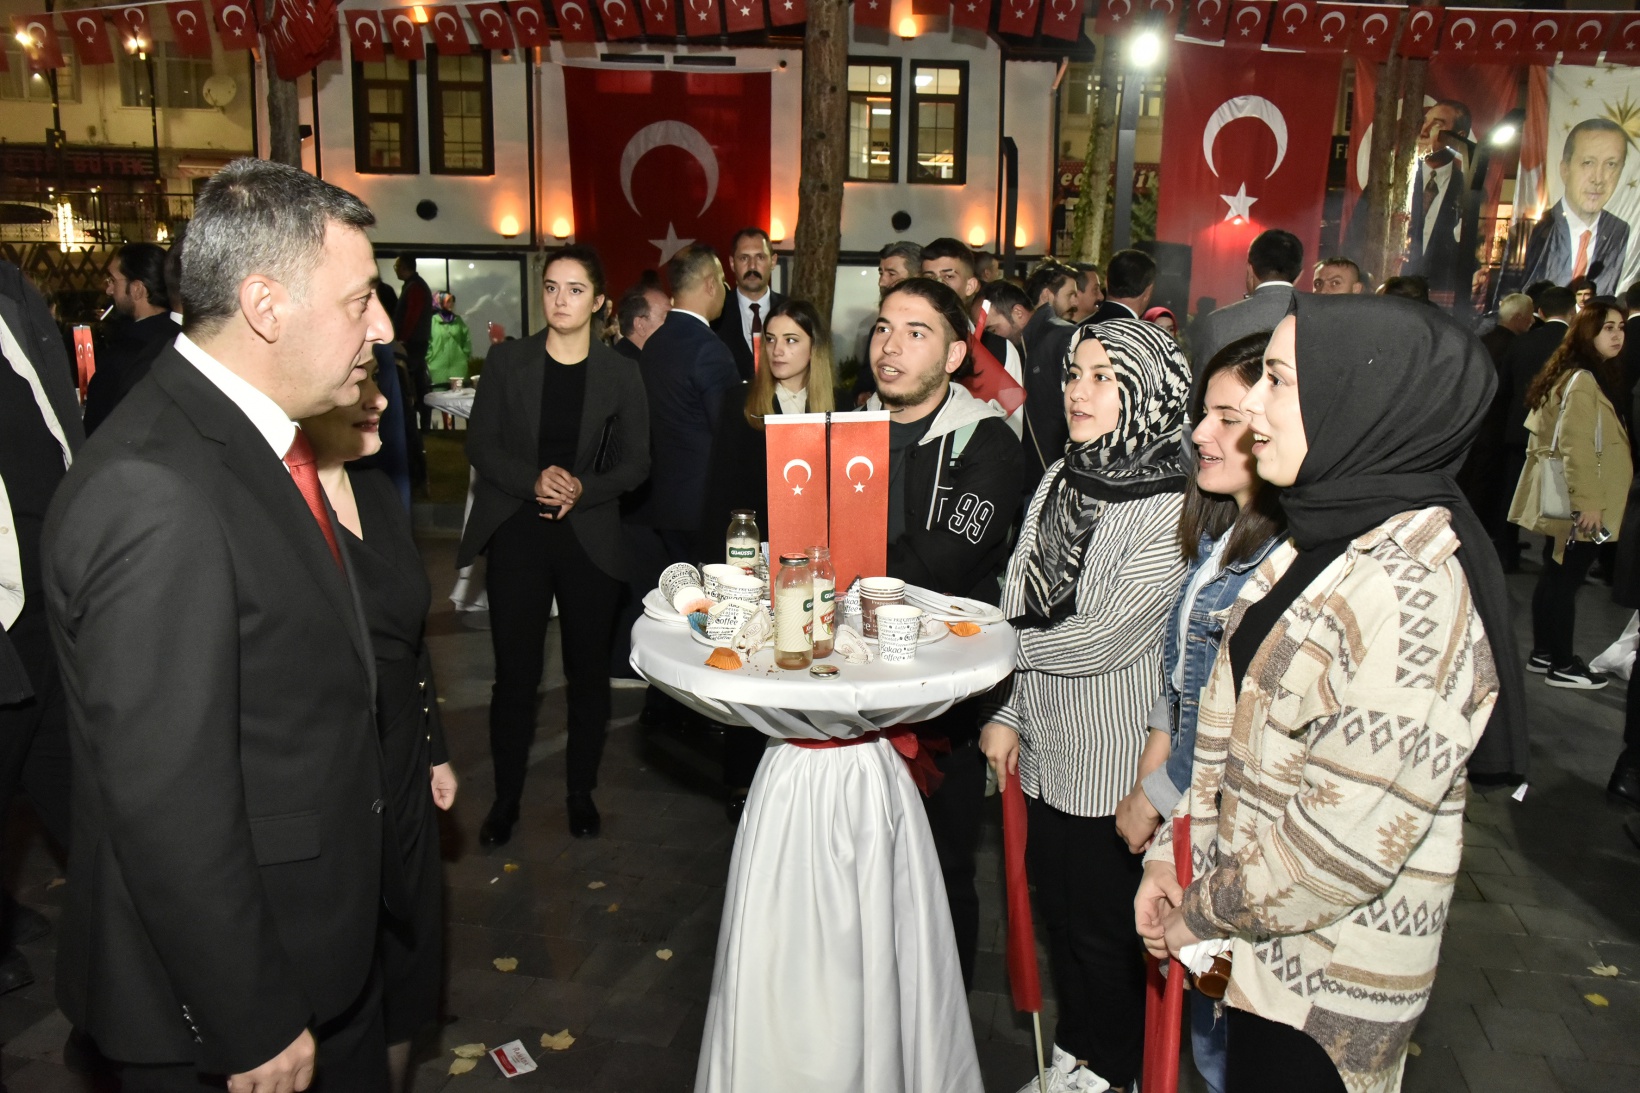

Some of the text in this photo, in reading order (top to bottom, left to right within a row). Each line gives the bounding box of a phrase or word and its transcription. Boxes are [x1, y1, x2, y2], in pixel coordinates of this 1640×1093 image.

[948, 492, 995, 545] 99
[881, 644, 902, 654] Kakao
[881, 651, 902, 662] Coffee
